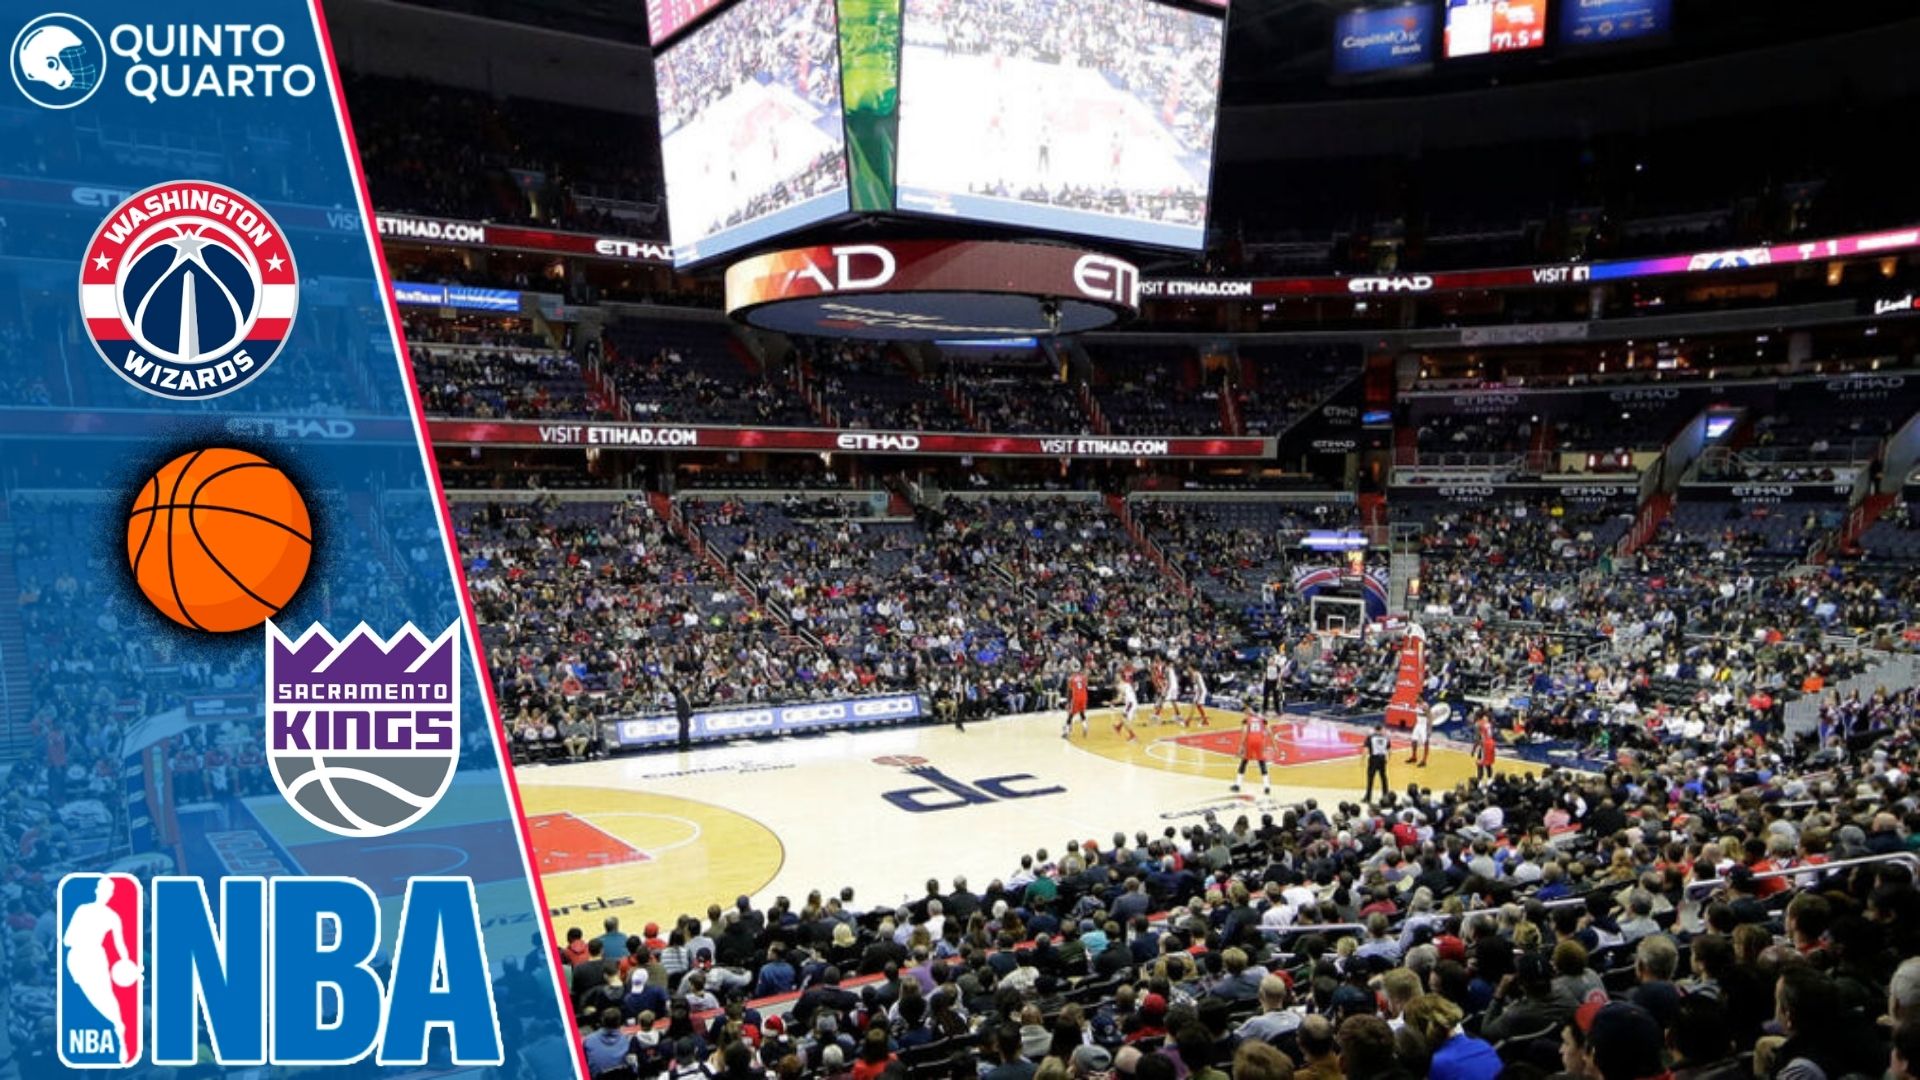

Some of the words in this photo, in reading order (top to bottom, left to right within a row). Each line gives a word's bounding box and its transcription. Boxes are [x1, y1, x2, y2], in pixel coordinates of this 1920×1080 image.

[326, 211, 360, 230] VISI
[376, 217, 485, 242] ETIHAD.COM
[1532, 266, 1568, 283] VISIT
[1167, 282, 1251, 295] ETIHAD.COM
[1349, 277, 1433, 292] ETIHAD
[539, 427, 581, 443] VISIT
[587, 427, 697, 445] ETIHAD.COM
[837, 434, 919, 450] ETIHAD
[1312, 439, 1356, 448] ETIHAD
[1040, 439, 1074, 454] VISIT
[1078, 440, 1167, 455] ETIHAD.COM
[1438, 487, 1494, 496] ETIHAD
[1560, 487, 1618, 496] ETIHAD
[1732, 487, 1793, 496] ETIHAD
[781, 704, 846, 726] GEICO
[853, 697, 914, 717] GEICO
[624, 715, 696, 738] GEIC
[705, 709, 774, 732] GEICO
